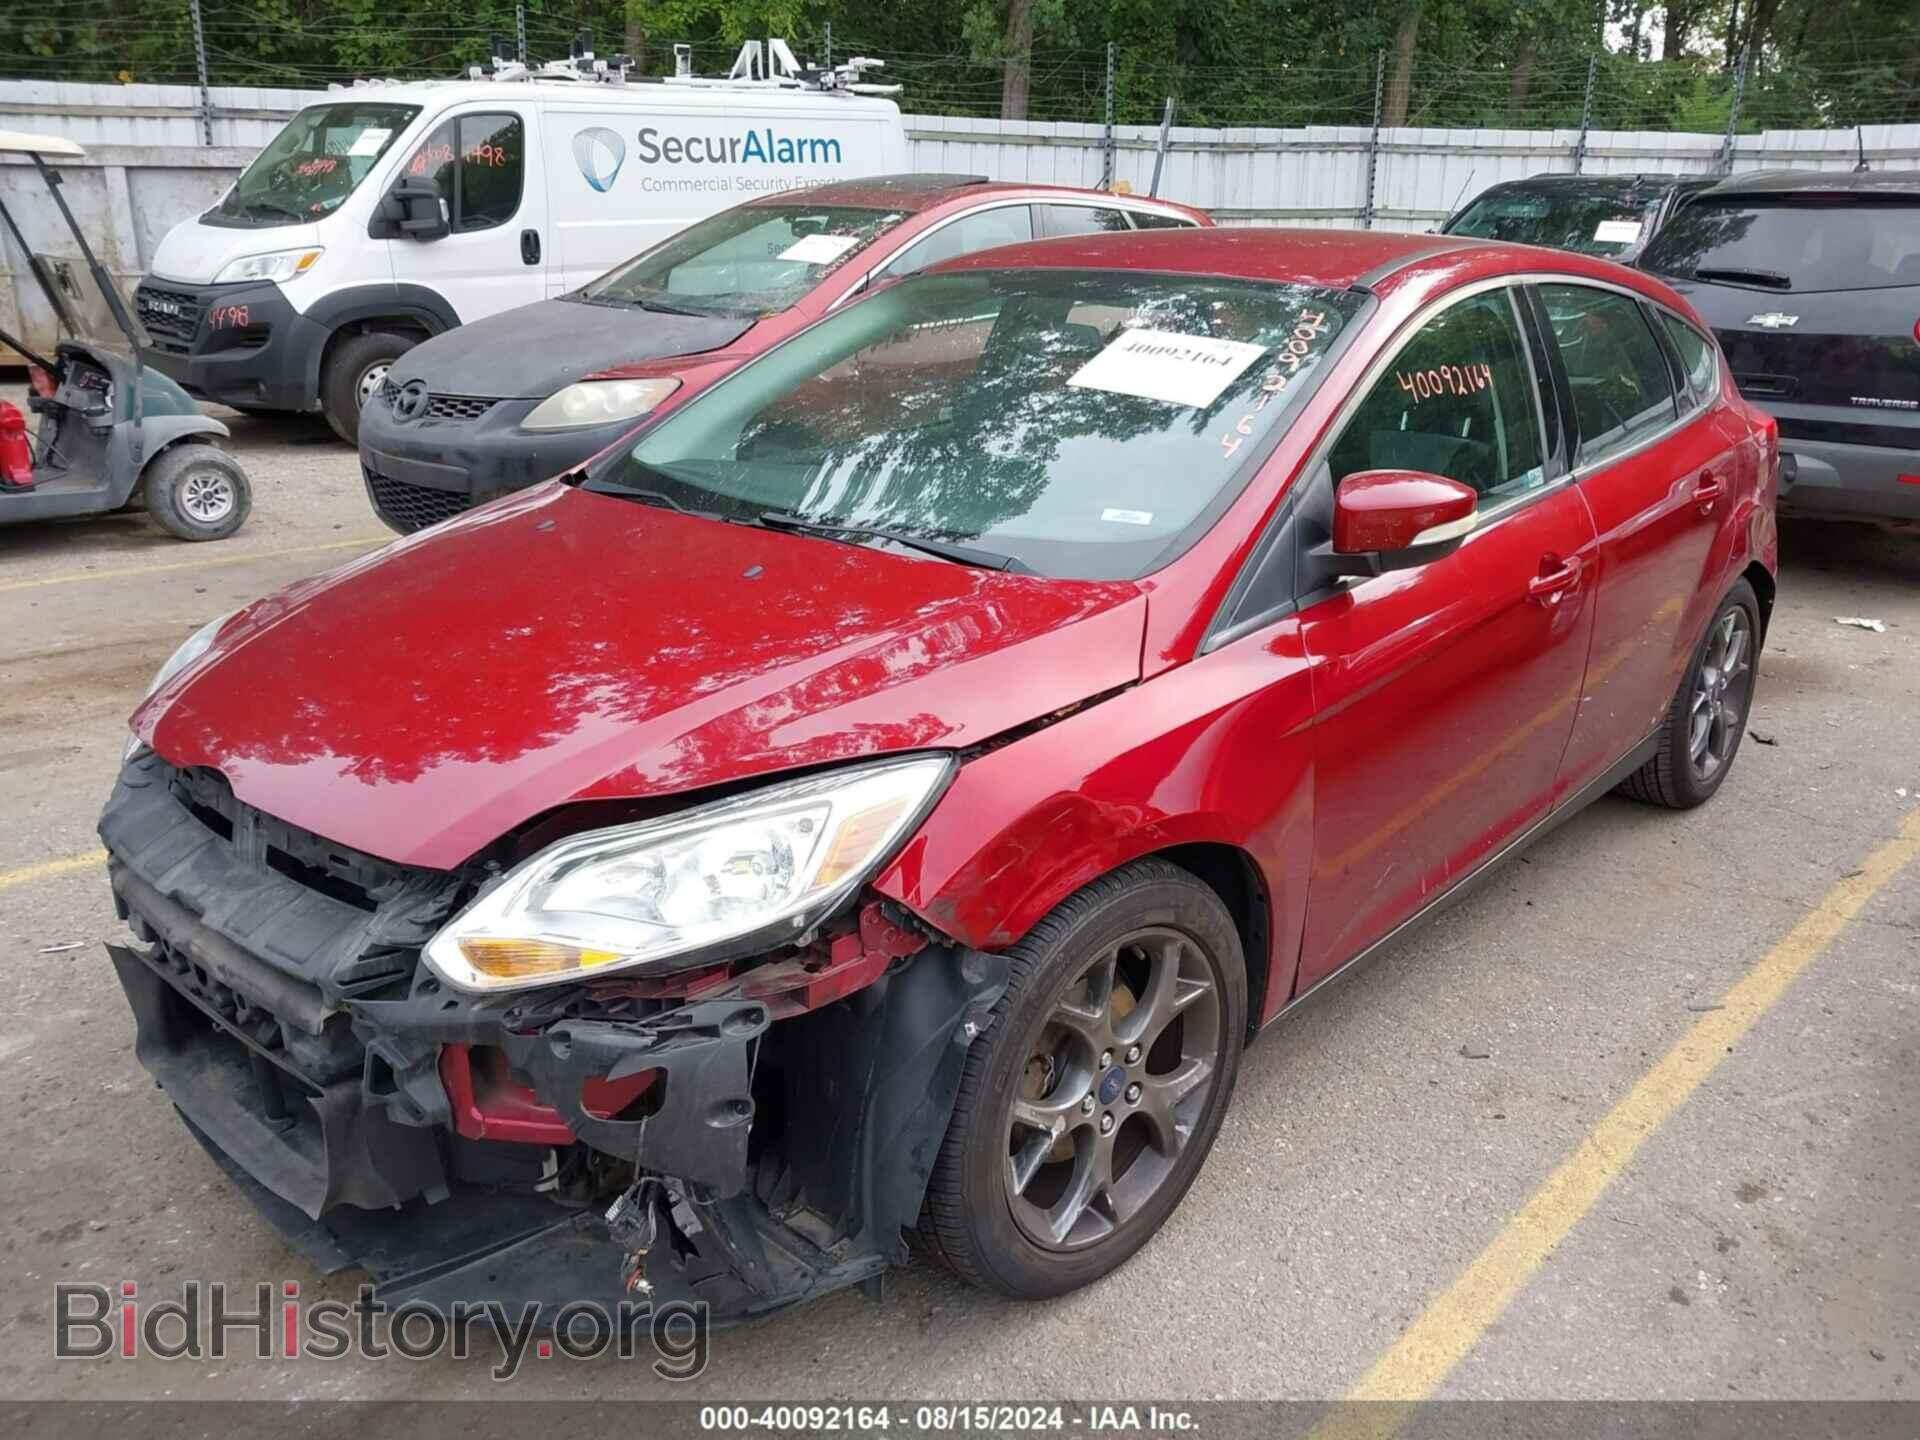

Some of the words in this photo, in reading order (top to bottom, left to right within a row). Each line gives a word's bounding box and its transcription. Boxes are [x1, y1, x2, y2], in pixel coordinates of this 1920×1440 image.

[637, 127, 842, 164] SecurAlarm
[641, 176, 732, 192] Commercial
[736, 175, 792, 194] Security
[209, 305, 249, 330] 4498
[1122, 342, 1234, 367] 40092164
[1396, 363, 1494, 404] 40092164
